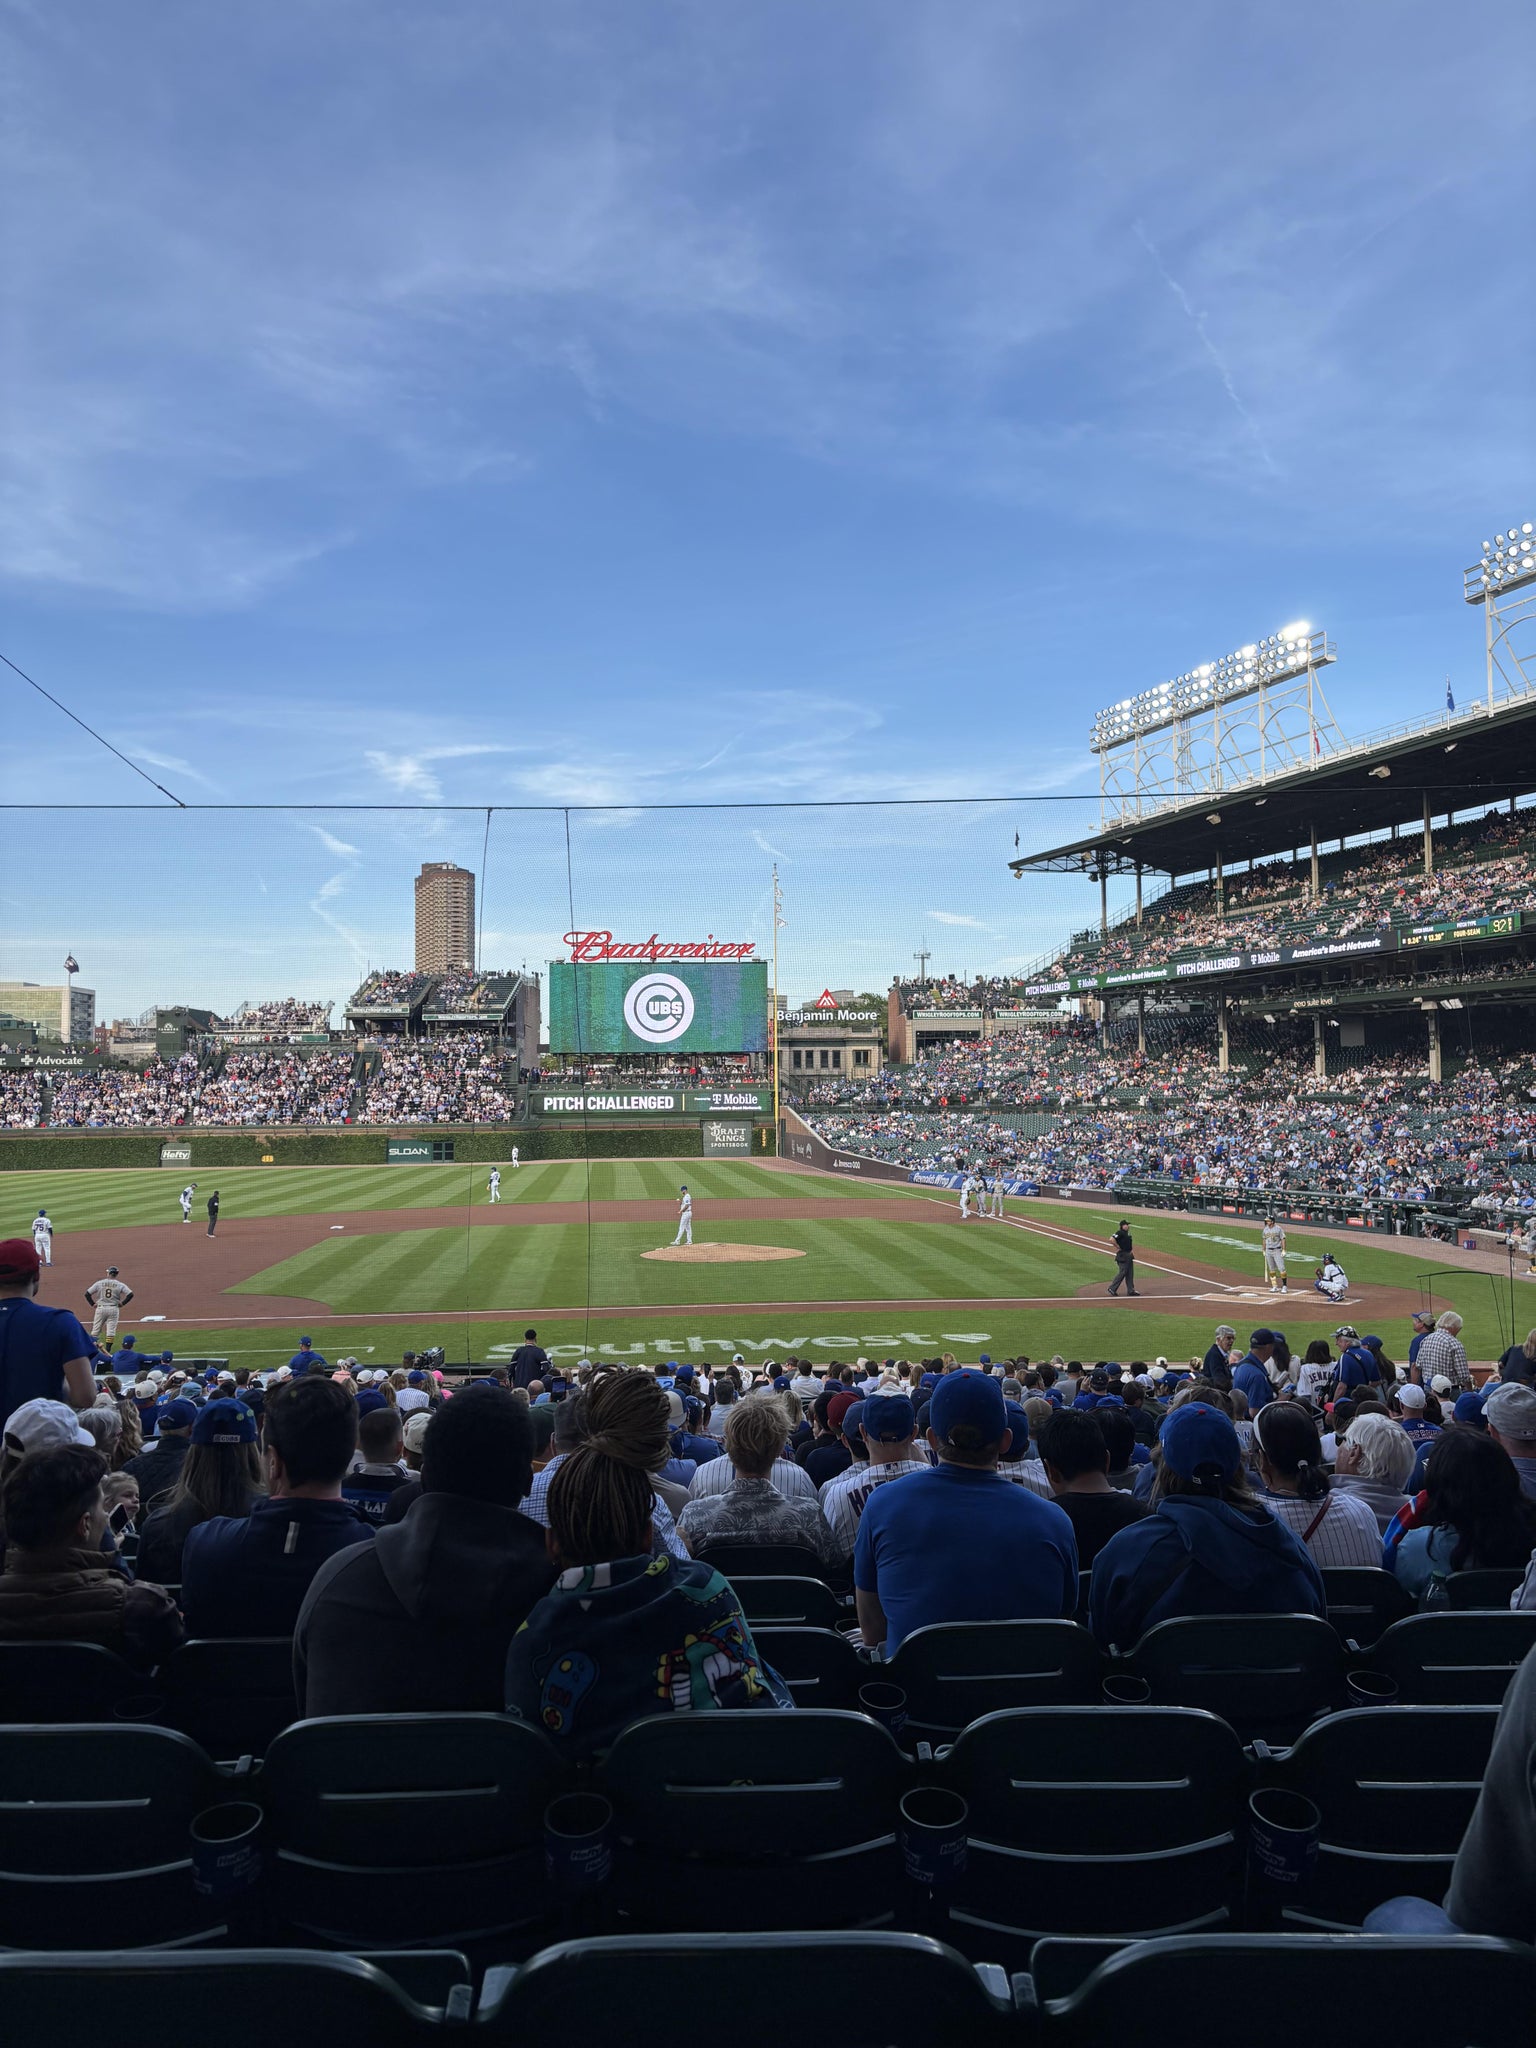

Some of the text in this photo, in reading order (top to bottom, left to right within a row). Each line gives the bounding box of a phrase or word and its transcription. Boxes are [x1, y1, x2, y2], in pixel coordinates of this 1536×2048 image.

[1493, 919, 1506, 932] 92
[563, 930, 756, 962] Budweiser
[1292, 938, 1381, 959] America's Best Network
[1258, 952, 1280, 964] Mobile
[1177, 956, 1240, 976] PITCH CHALLENGED
[1106, 974, 1131, 984] America's
[1143, 969, 1167, 979] Network
[1025, 981, 1070, 996] PITCH CHALLENGED
[1082, 978, 1098, 988] Mobile
[1320, 996, 1332, 1005] level
[776, 1010, 877, 1023] Benjamin Moore
[35, 1056, 83, 1065] Advocate
[544, 1096, 674, 1110] PITCH CHALLENGED
[724, 1094, 758, 1104] Mobile
[710, 1128, 746, 1136] DRAFT
[162, 1151, 188, 1159] Hefty
[913, 1172, 935, 1186] Reynolds
[35, 1224, 44, 1232] 75
[105, 1288, 112, 1298] 8
